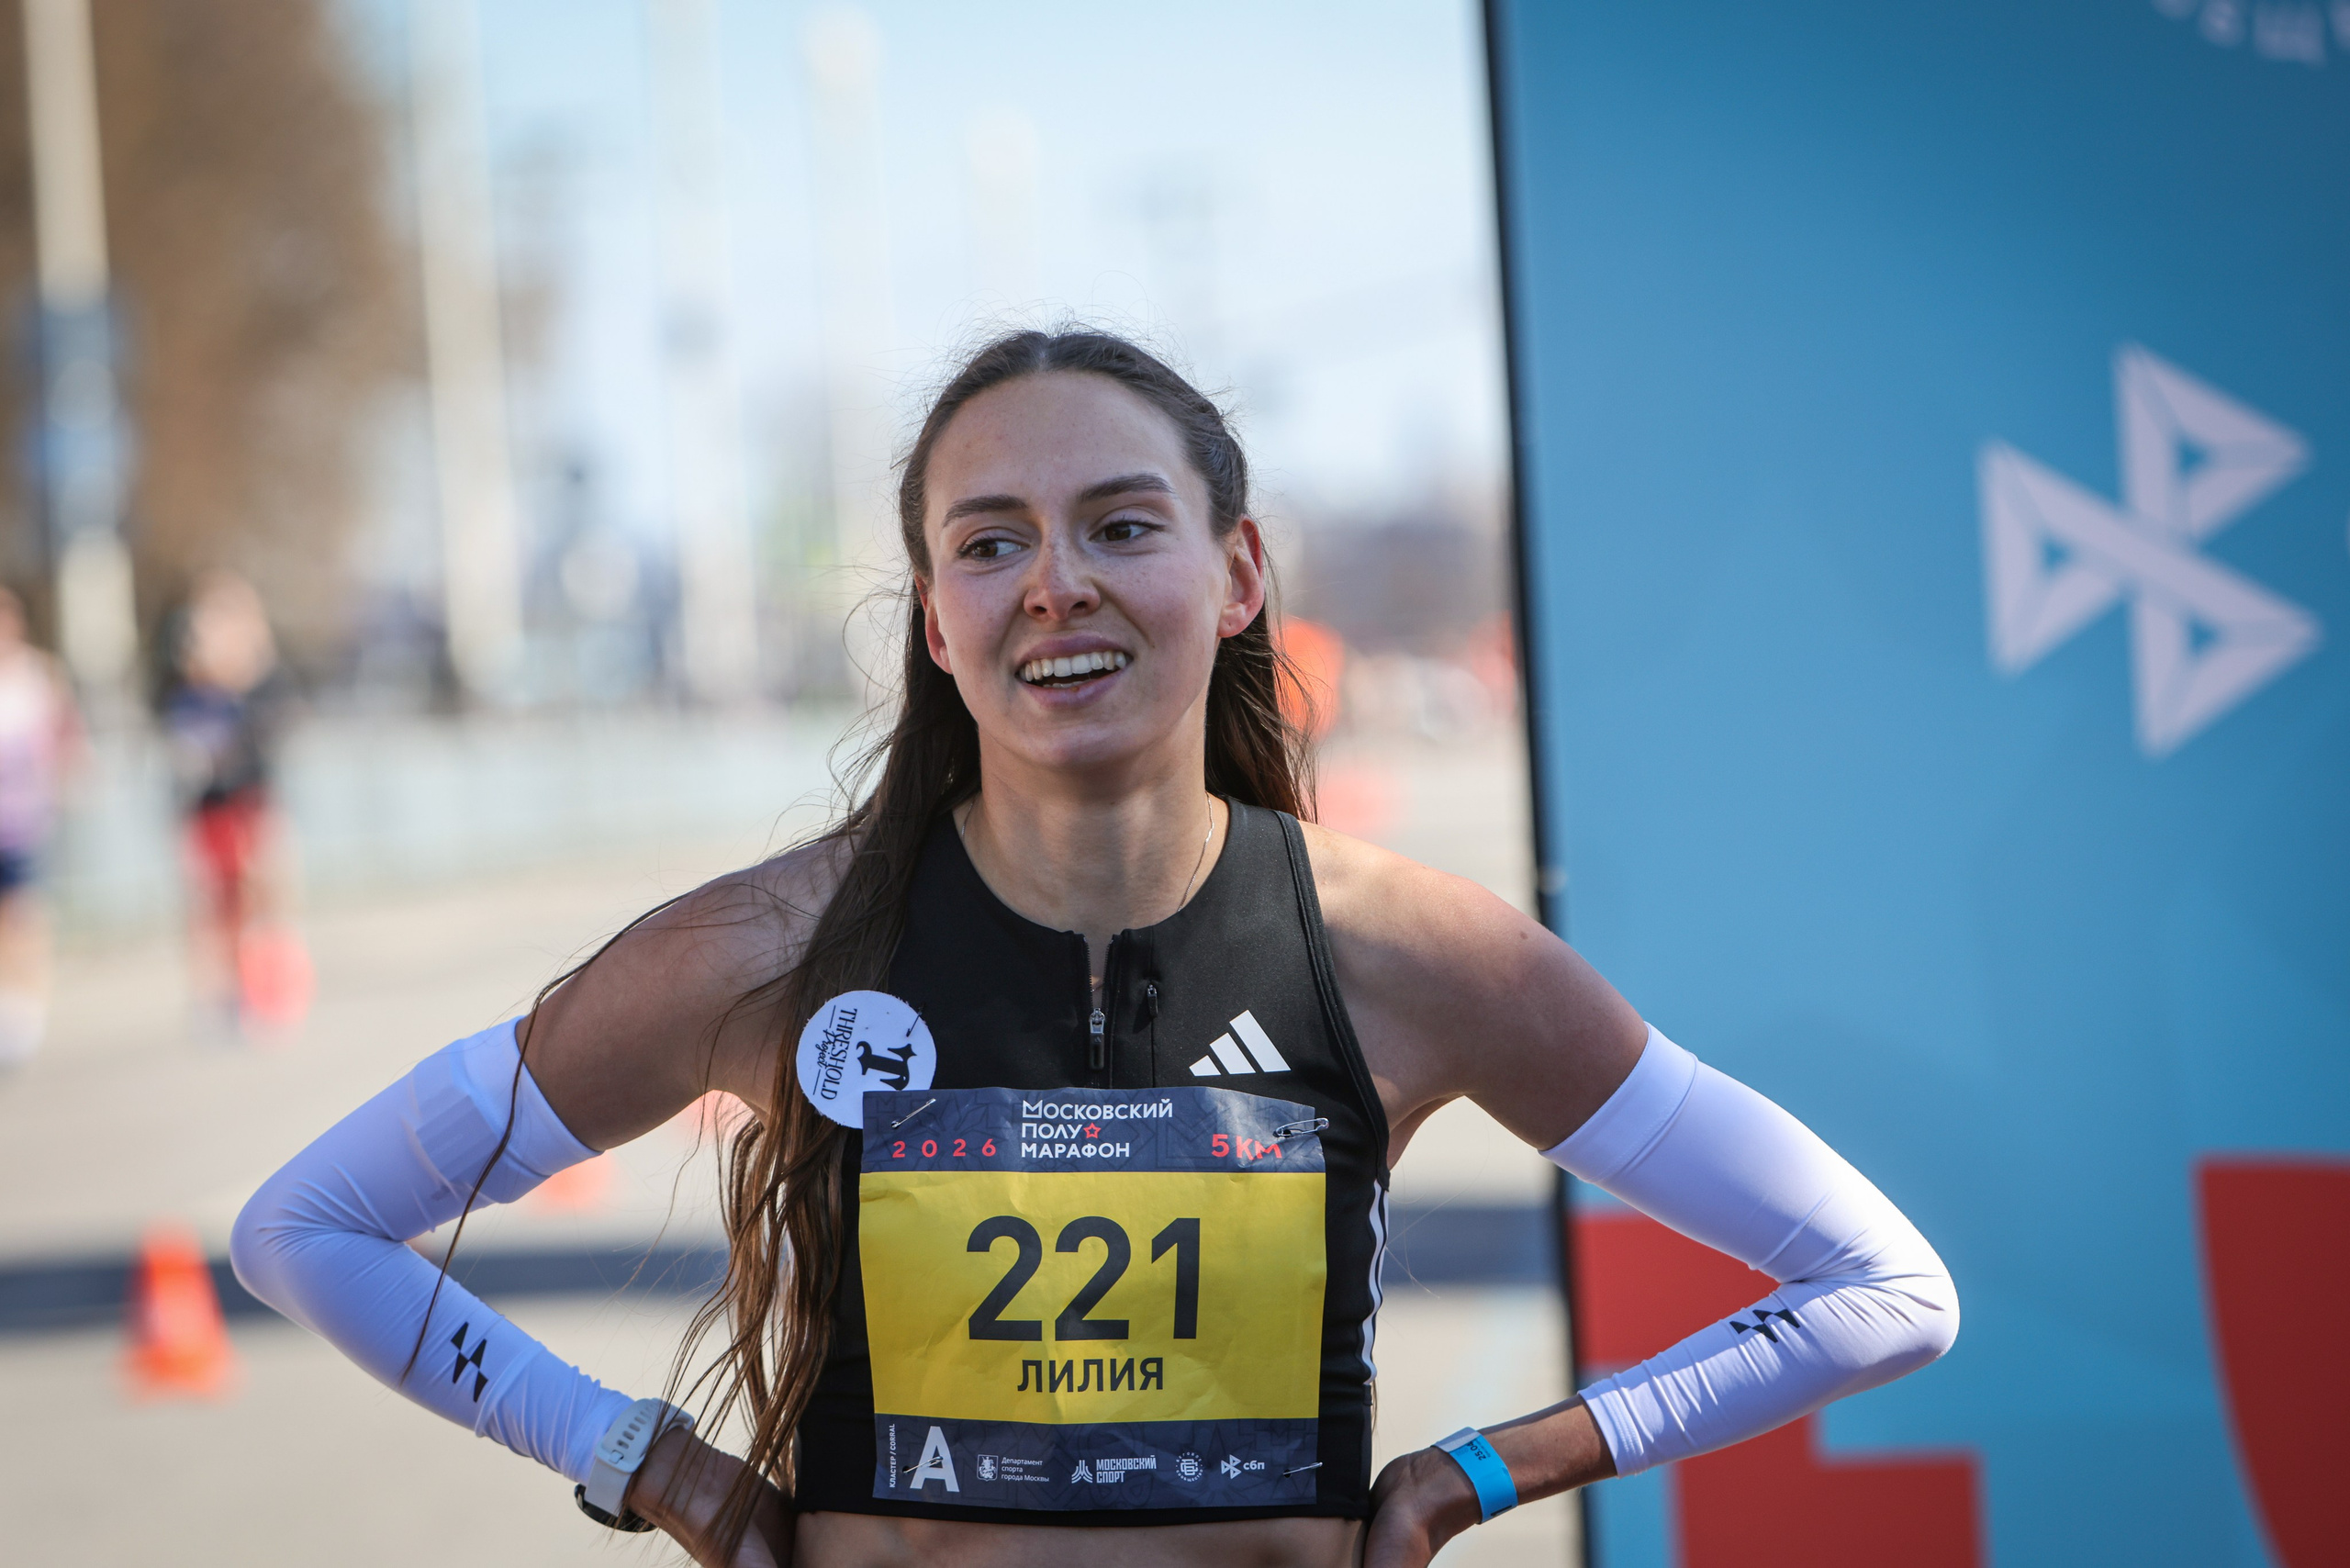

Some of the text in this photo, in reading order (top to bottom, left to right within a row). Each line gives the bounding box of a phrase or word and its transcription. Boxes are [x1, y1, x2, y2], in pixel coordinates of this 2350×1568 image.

[815, 1028, 837, 1070] Project
[821, 1008, 857, 1100] THRESHOLD
[1021, 1123, 1082, 1139] ПОЛУ
[1021, 1143, 1130, 1159] МАРАФОН
[1212, 1134, 1230, 1158] 5
[967, 1215, 1201, 1341] 221
[1017, 1357, 1163, 1393] ЛИЛИЯ
[889, 1423, 897, 1450] CORRAL
[889, 1456, 897, 1488] КЛАСТЕР
[1001, 1457, 1043, 1466] Департамент
[1096, 1455, 1157, 1471] МОСКОВСКИЙ
[1001, 1473, 1050, 1483] города Москвы
[1096, 1471, 1125, 1484] СПОРТ
